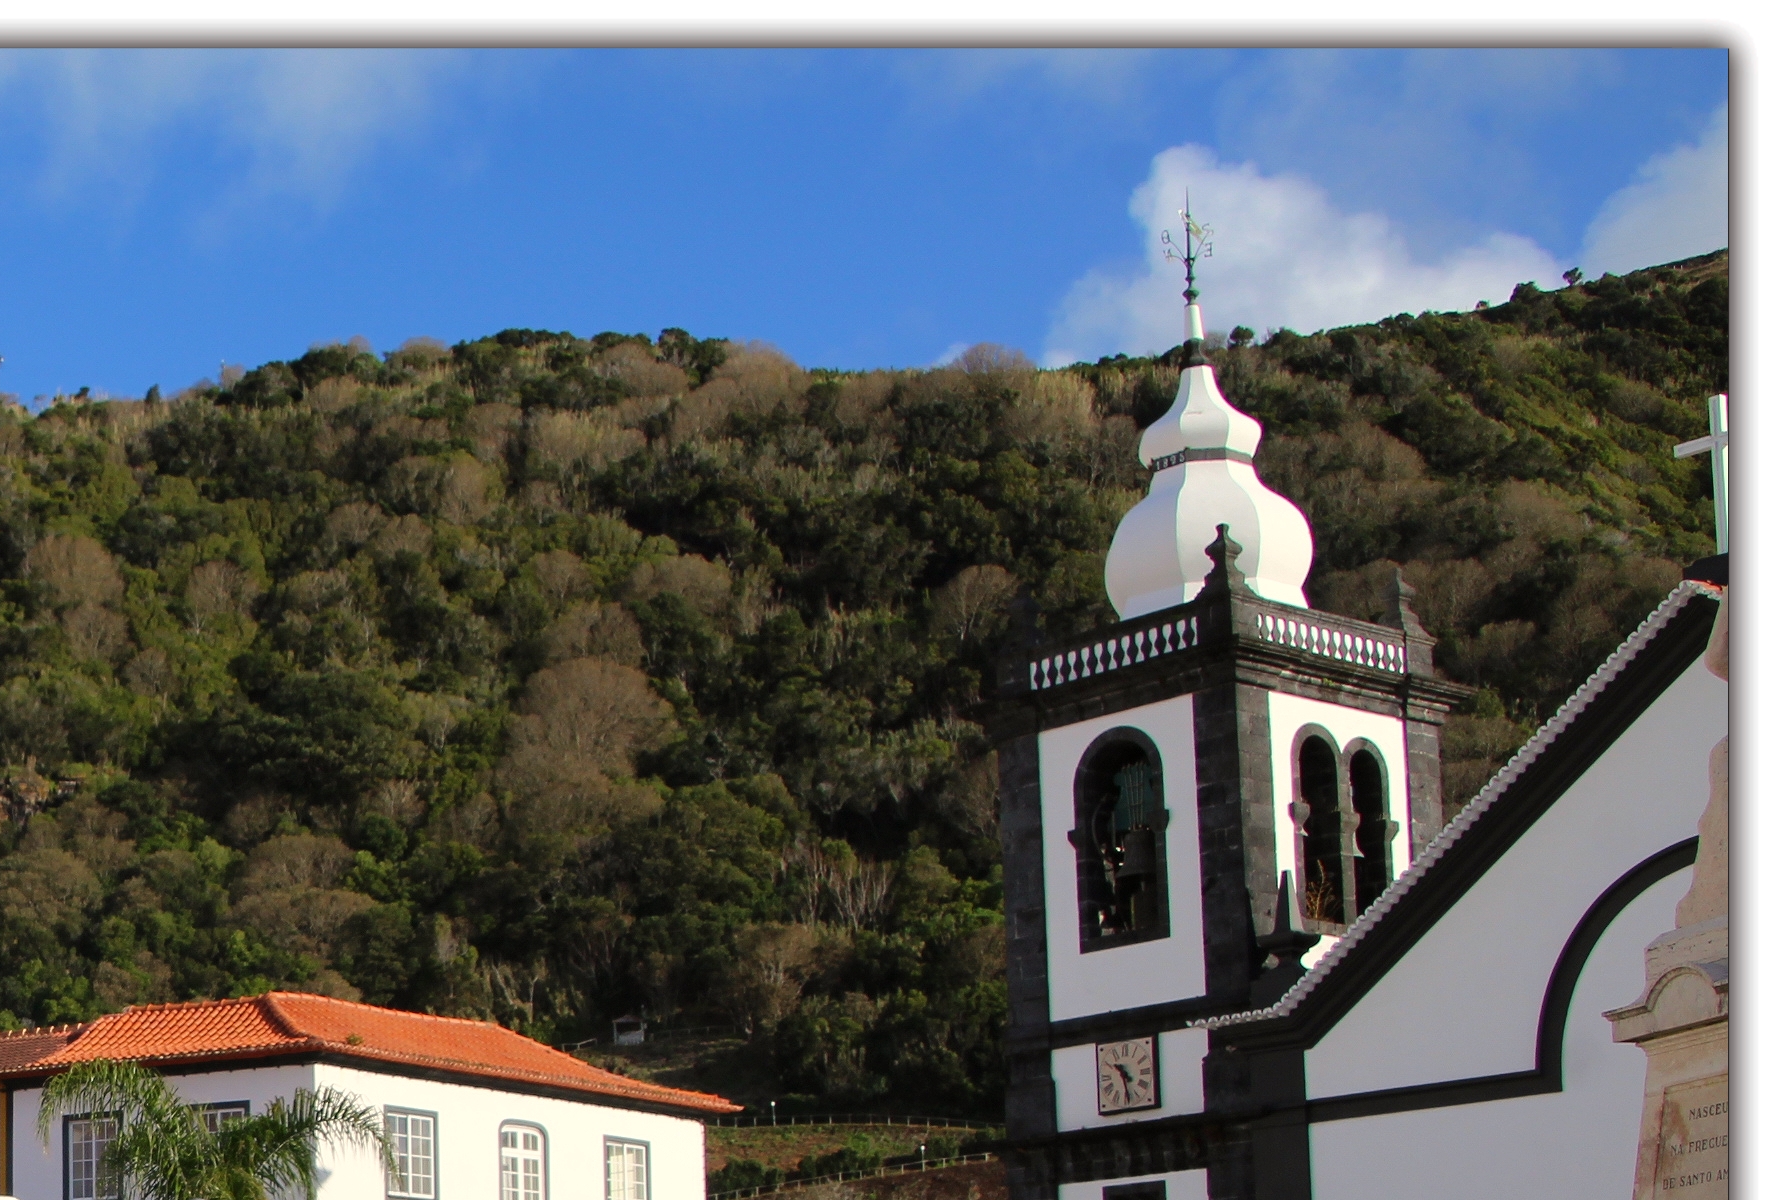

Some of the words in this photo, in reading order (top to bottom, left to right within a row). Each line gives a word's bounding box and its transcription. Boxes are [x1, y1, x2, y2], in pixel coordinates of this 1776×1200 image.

[1689, 1102, 1728, 1120] NASCEU
[1663, 1178, 1675, 1190] DE
[1680, 1172, 1712, 1187] SANTO
